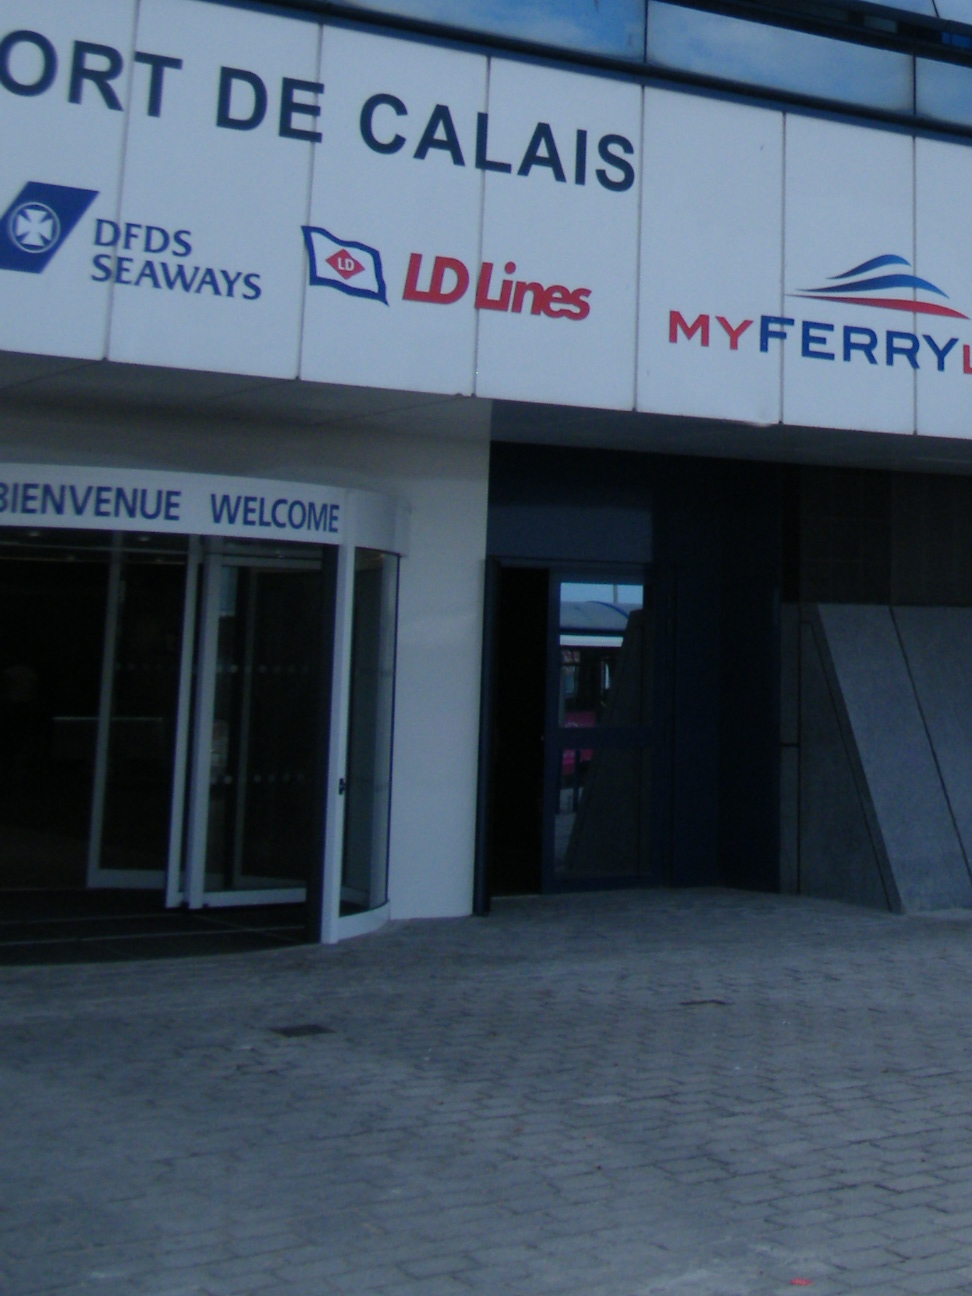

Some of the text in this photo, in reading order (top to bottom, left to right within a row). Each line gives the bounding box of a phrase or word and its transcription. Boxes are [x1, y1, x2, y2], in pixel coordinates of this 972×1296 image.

[215, 65, 325, 144] DE
[358, 92, 636, 193] CALAIS
[93, 218, 193, 257] DFDS
[90, 253, 262, 300] SEAWAYS
[337, 257, 355, 272] LD
[402, 252, 592, 321] LD Lines
[210, 493, 341, 534] WELCOME
